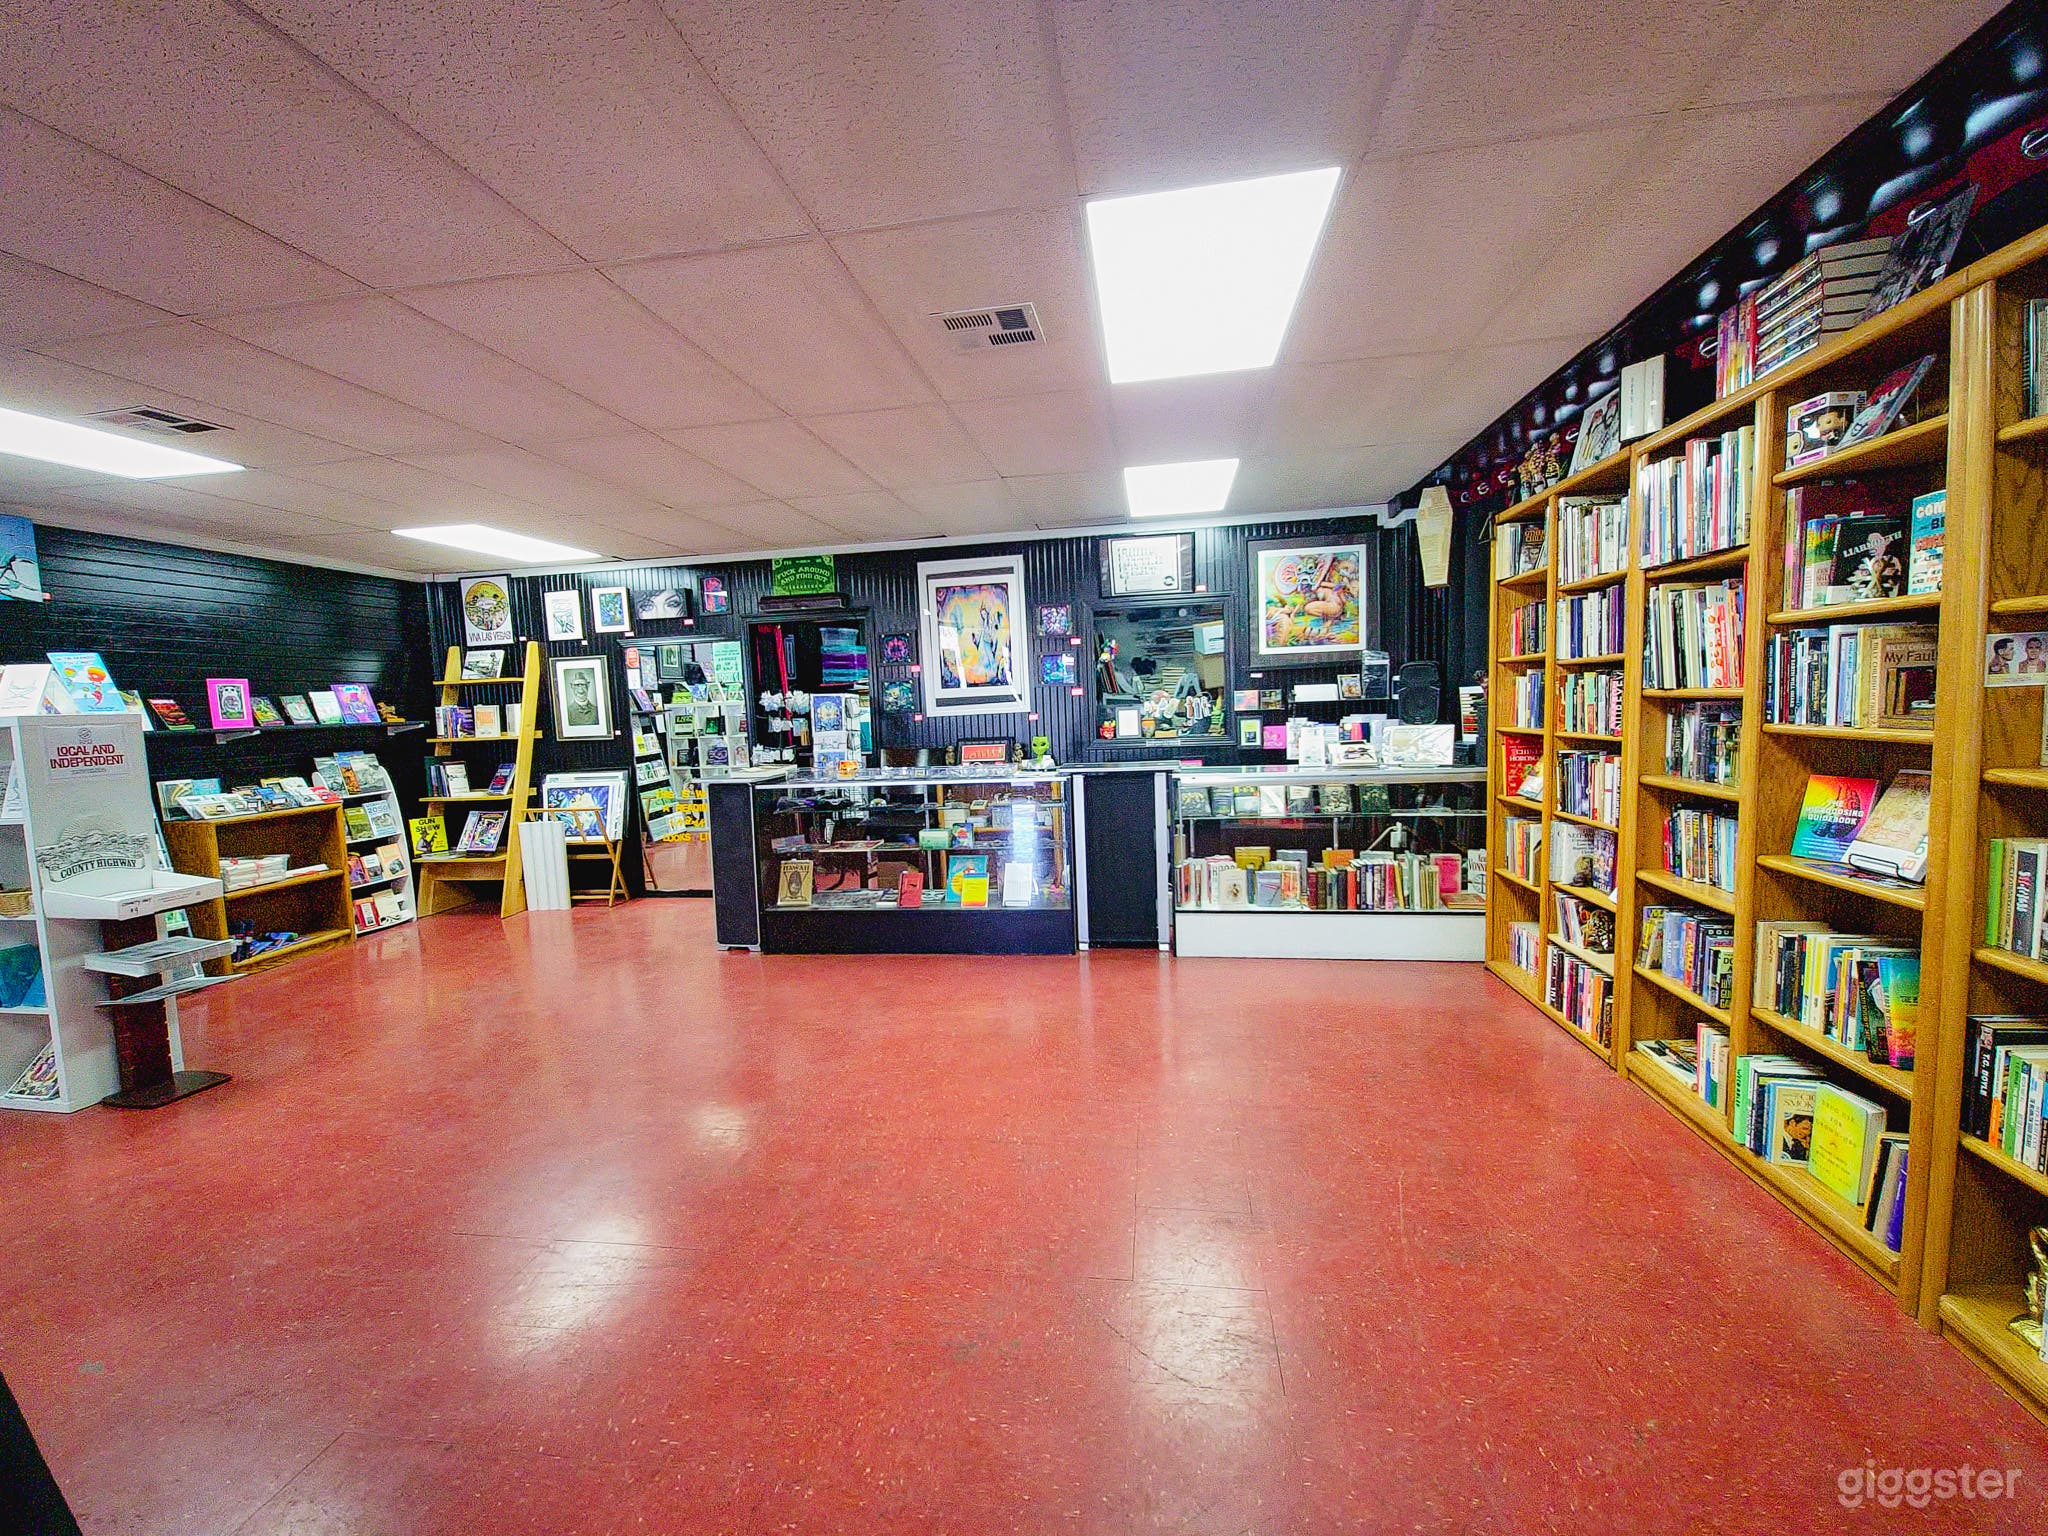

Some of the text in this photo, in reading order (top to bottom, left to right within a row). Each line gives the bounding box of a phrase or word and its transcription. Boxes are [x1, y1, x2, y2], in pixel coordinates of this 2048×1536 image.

[777, 566, 830, 580] FUCK AROUND
[481, 632, 493, 641] LAS
[1884, 651, 1903, 665] My
[57, 744, 116, 757] LOCAL AND
[50, 754, 125, 769] INDEPENDENT
[1808, 813, 1858, 826] GUIDEBOOK
[60, 858, 137, 879] COUNTY HIGHWAY
[1980, 1053, 1992, 1097] T.C. BOYLE
